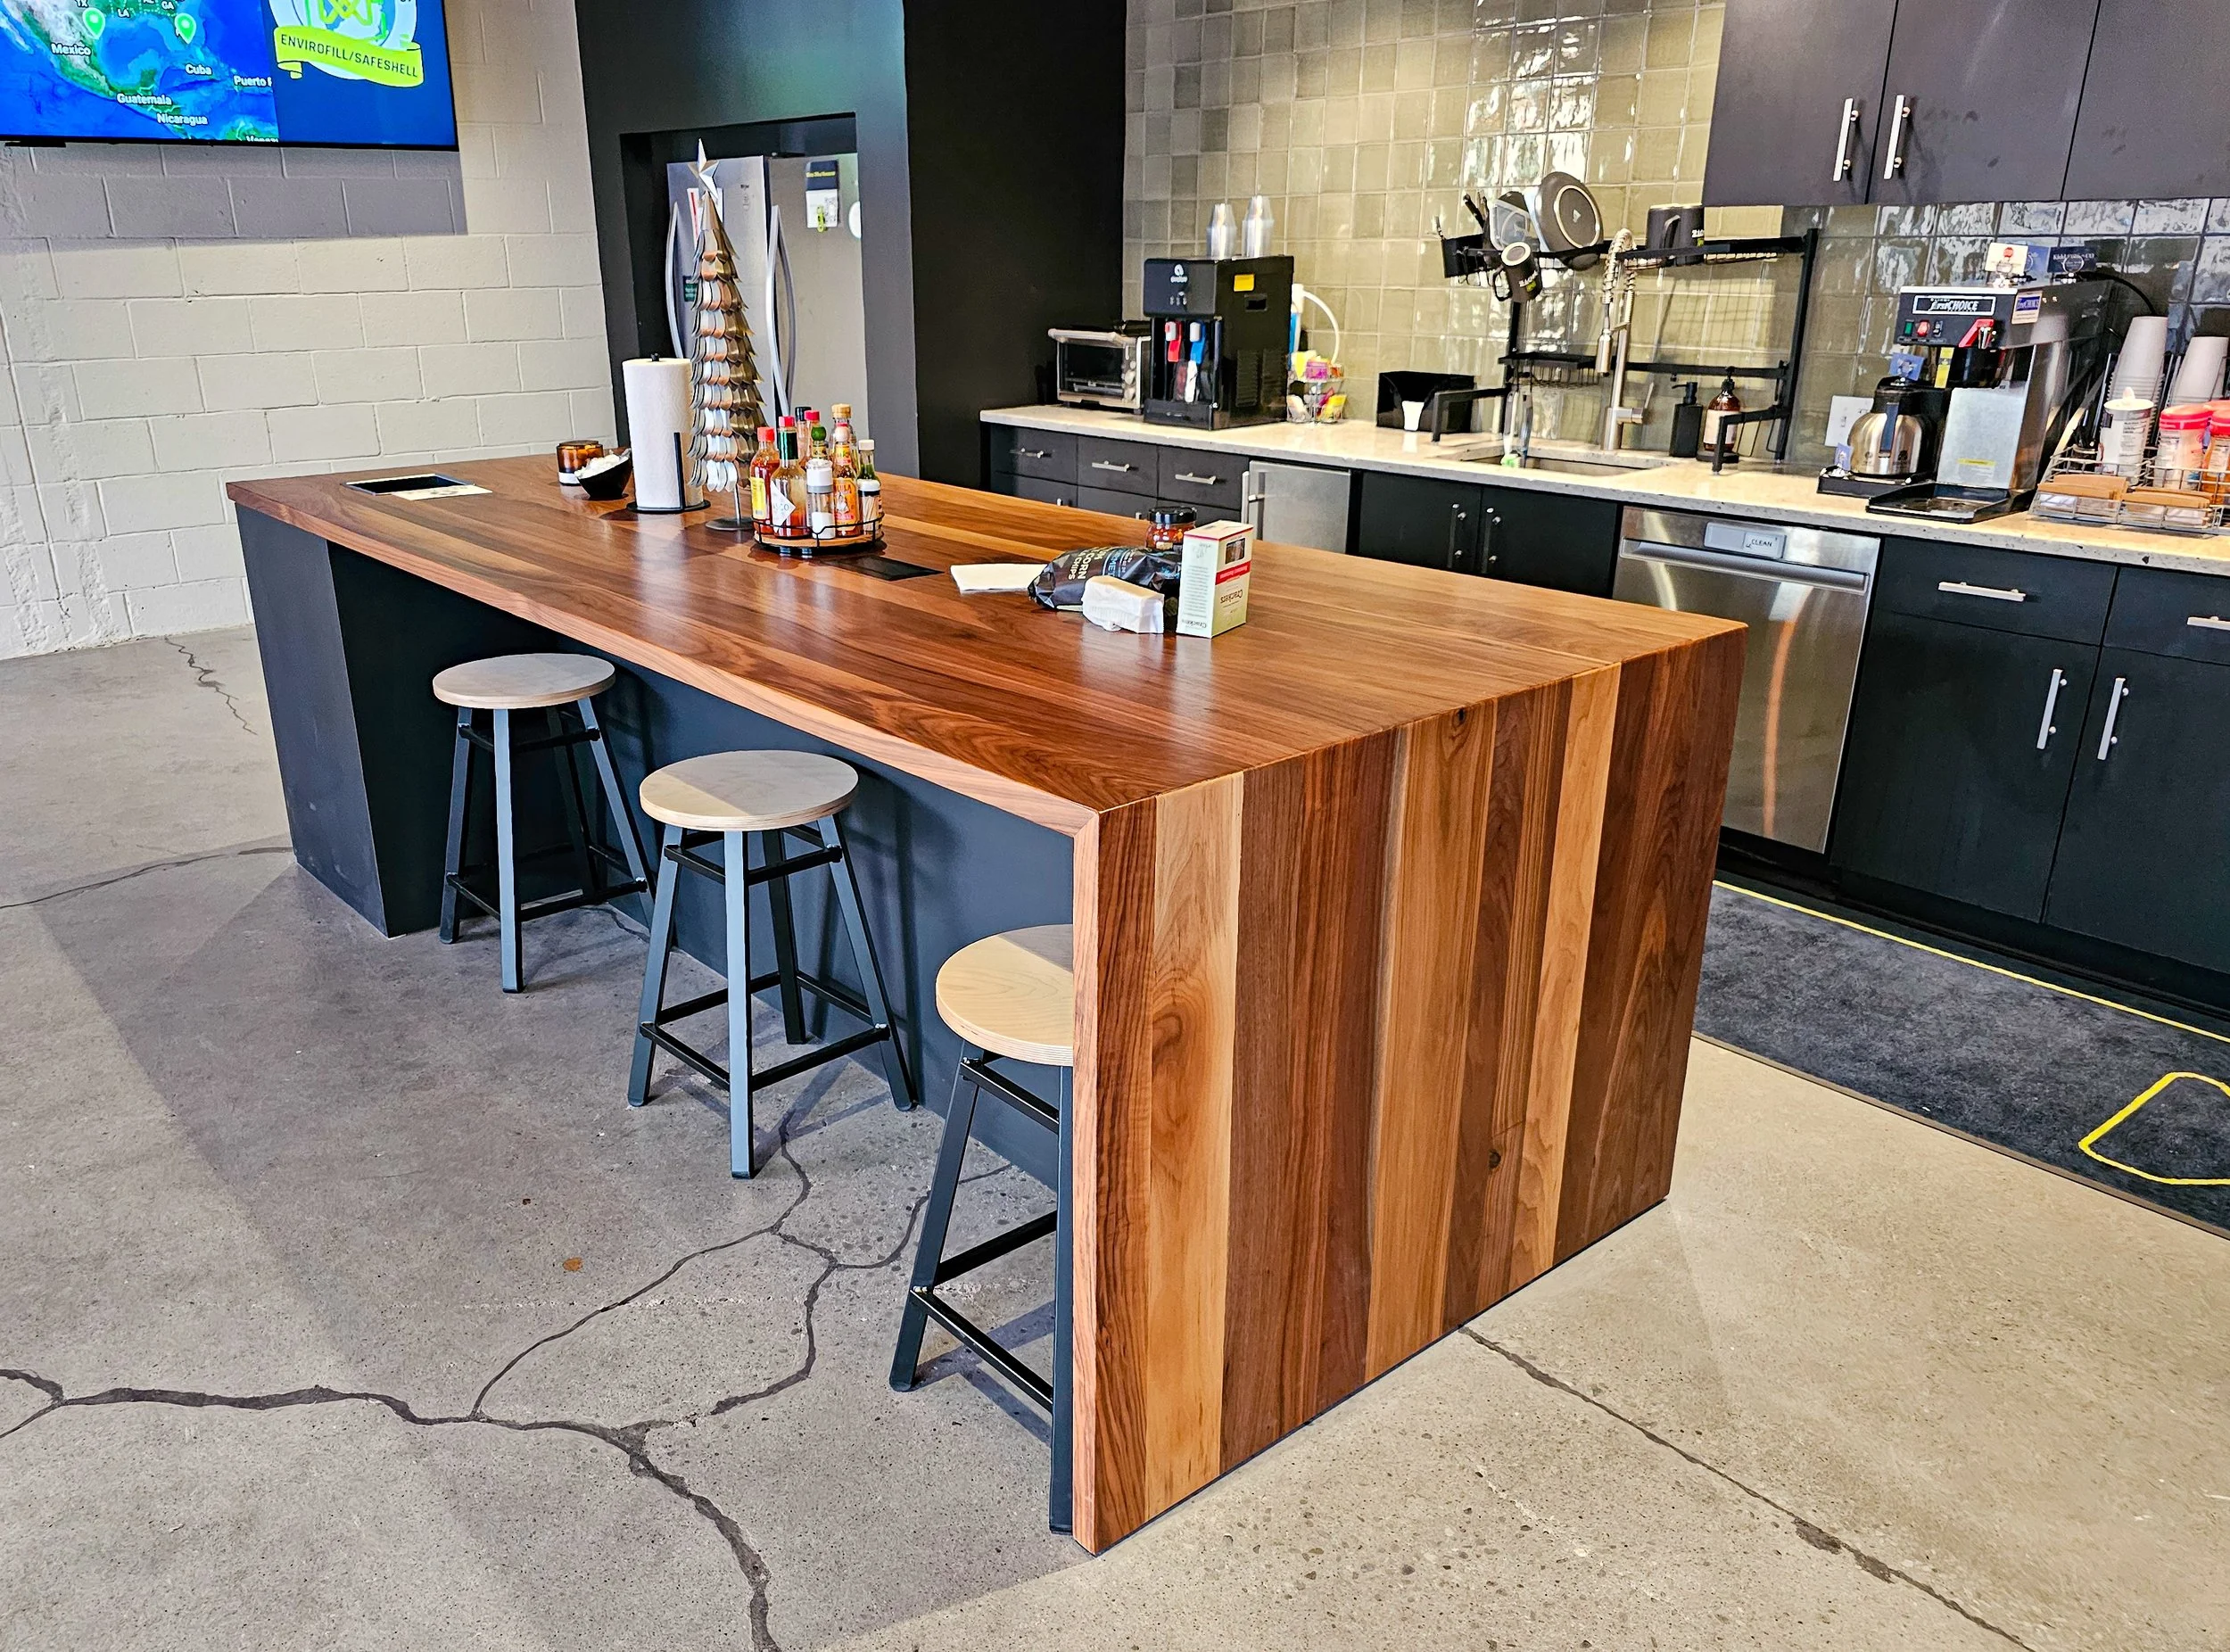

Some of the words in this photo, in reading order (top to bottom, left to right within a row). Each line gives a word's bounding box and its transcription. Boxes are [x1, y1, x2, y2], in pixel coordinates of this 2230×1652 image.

[161, 1, 175, 10] GA
[117, 8, 130, 17] LA
[51, 44, 91, 56] Mexico
[281, 34, 418, 78] ENVIROFILL/SAFESHELL
[185, 63, 212, 75] Cuba
[233, 75, 267, 87] Puerto
[116, 93, 172, 105] Guatemala
[156, 112, 208, 126] Nicaragua
[1751, 539, 1772, 547] CLEAN
[1068, 557, 1083, 580] CHIPS
[1078, 552, 1095, 580] CORN
[1220, 589, 1243, 604] Crackers
